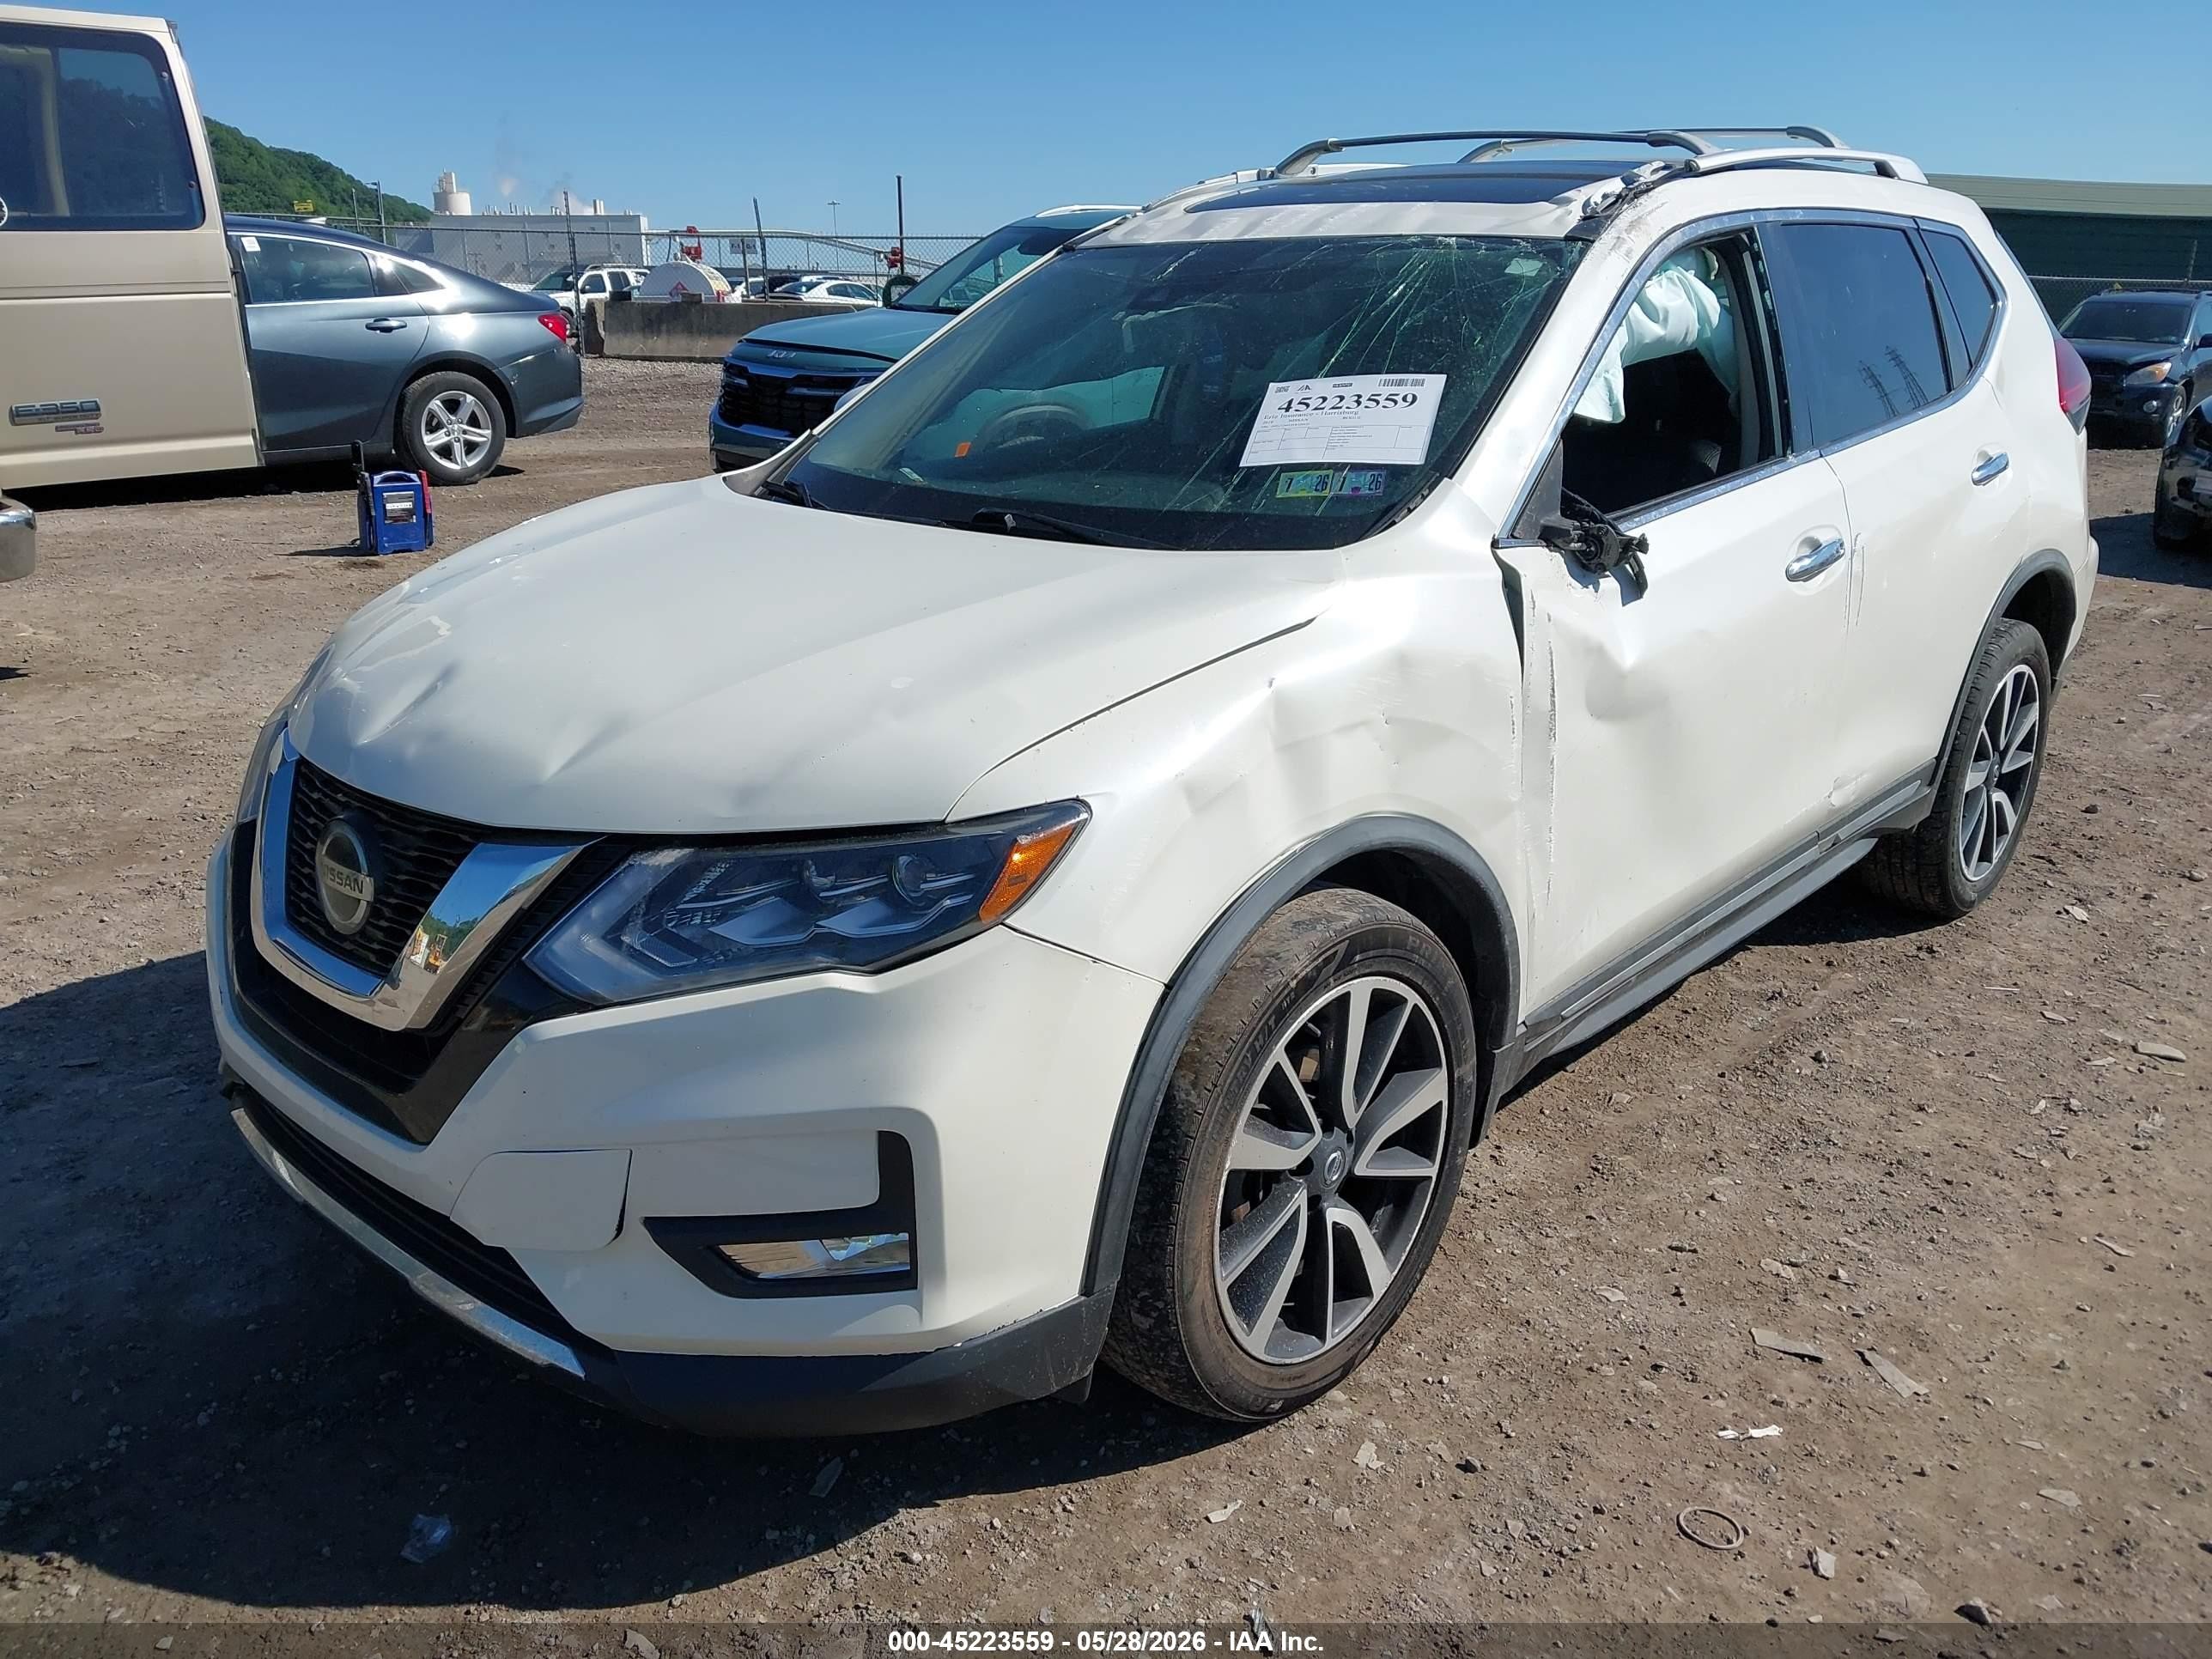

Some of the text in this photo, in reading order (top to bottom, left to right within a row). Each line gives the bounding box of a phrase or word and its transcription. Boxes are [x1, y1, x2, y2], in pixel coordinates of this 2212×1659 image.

[1277, 393, 1419, 413] 45223559
[1315, 474, 1329, 493] 26
[1368, 473, 1382, 492] 26
